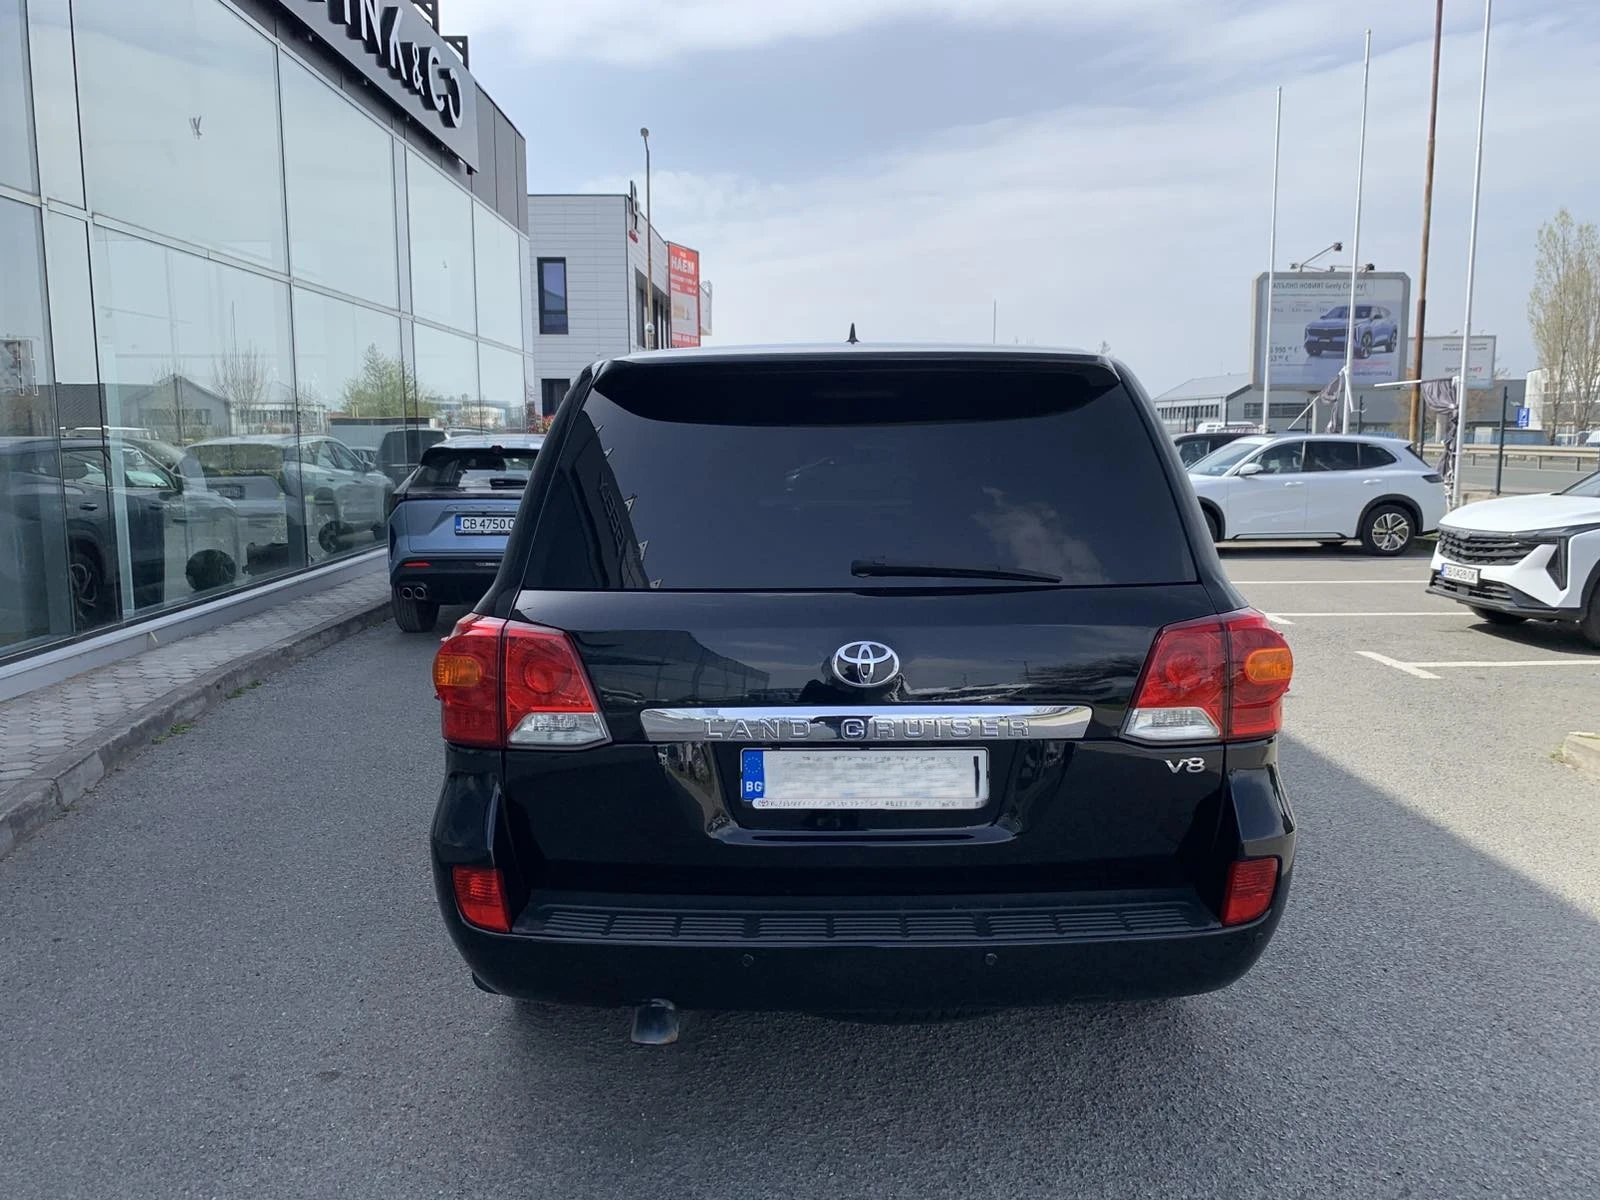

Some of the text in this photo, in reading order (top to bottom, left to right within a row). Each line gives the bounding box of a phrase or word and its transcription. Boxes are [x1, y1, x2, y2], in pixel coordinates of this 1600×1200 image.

[463, 518, 477, 530] CB
[480, 518, 506, 530] 4750
[704, 718, 1030, 740] LAND CRUISER
[1165, 757, 1205, 773] V8
[745, 781, 763, 792] BG
